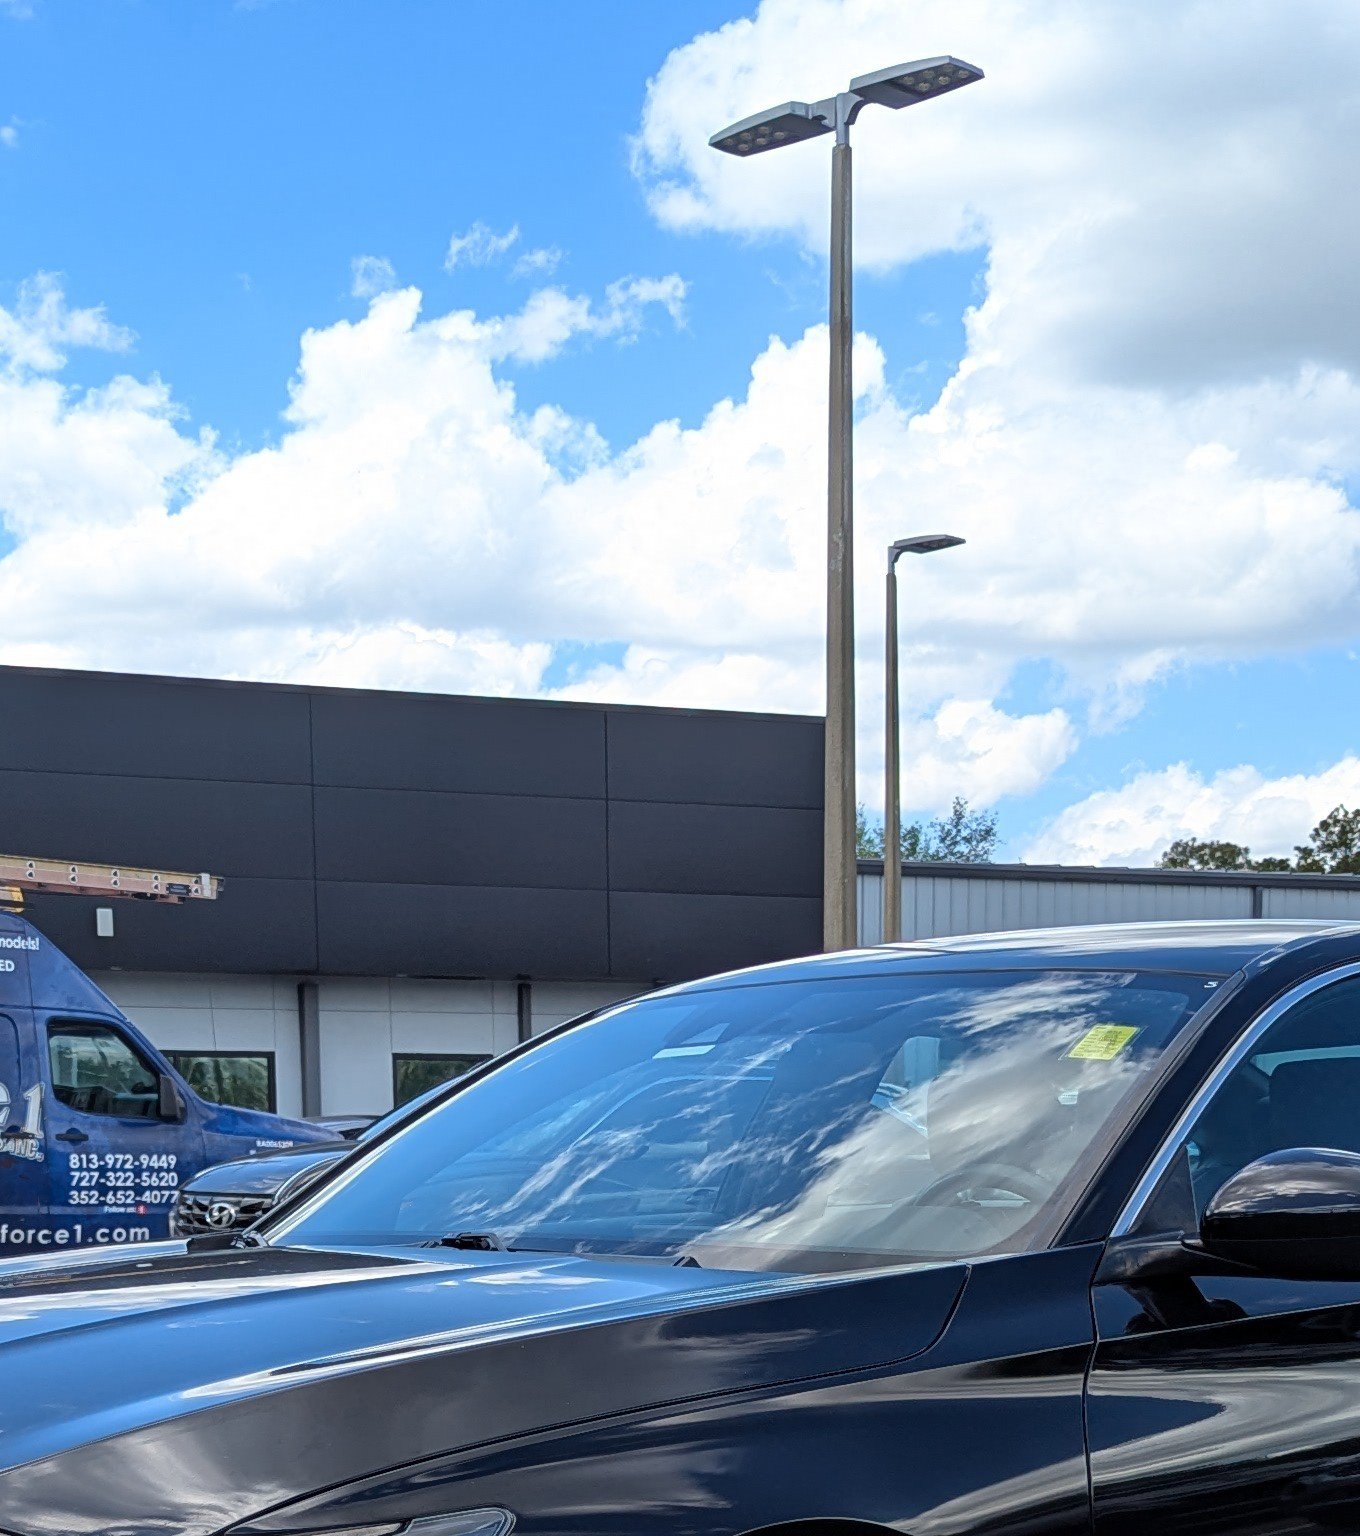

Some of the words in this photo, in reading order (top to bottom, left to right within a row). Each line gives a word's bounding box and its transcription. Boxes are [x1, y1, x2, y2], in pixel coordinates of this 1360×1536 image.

[23, 1081, 45, 1139] 1
[69, 1154, 177, 1169] 813-972-9449
[70, 1171, 178, 1187] 727-322-5620
[68, 1190, 180, 1205] 352-652-4077
